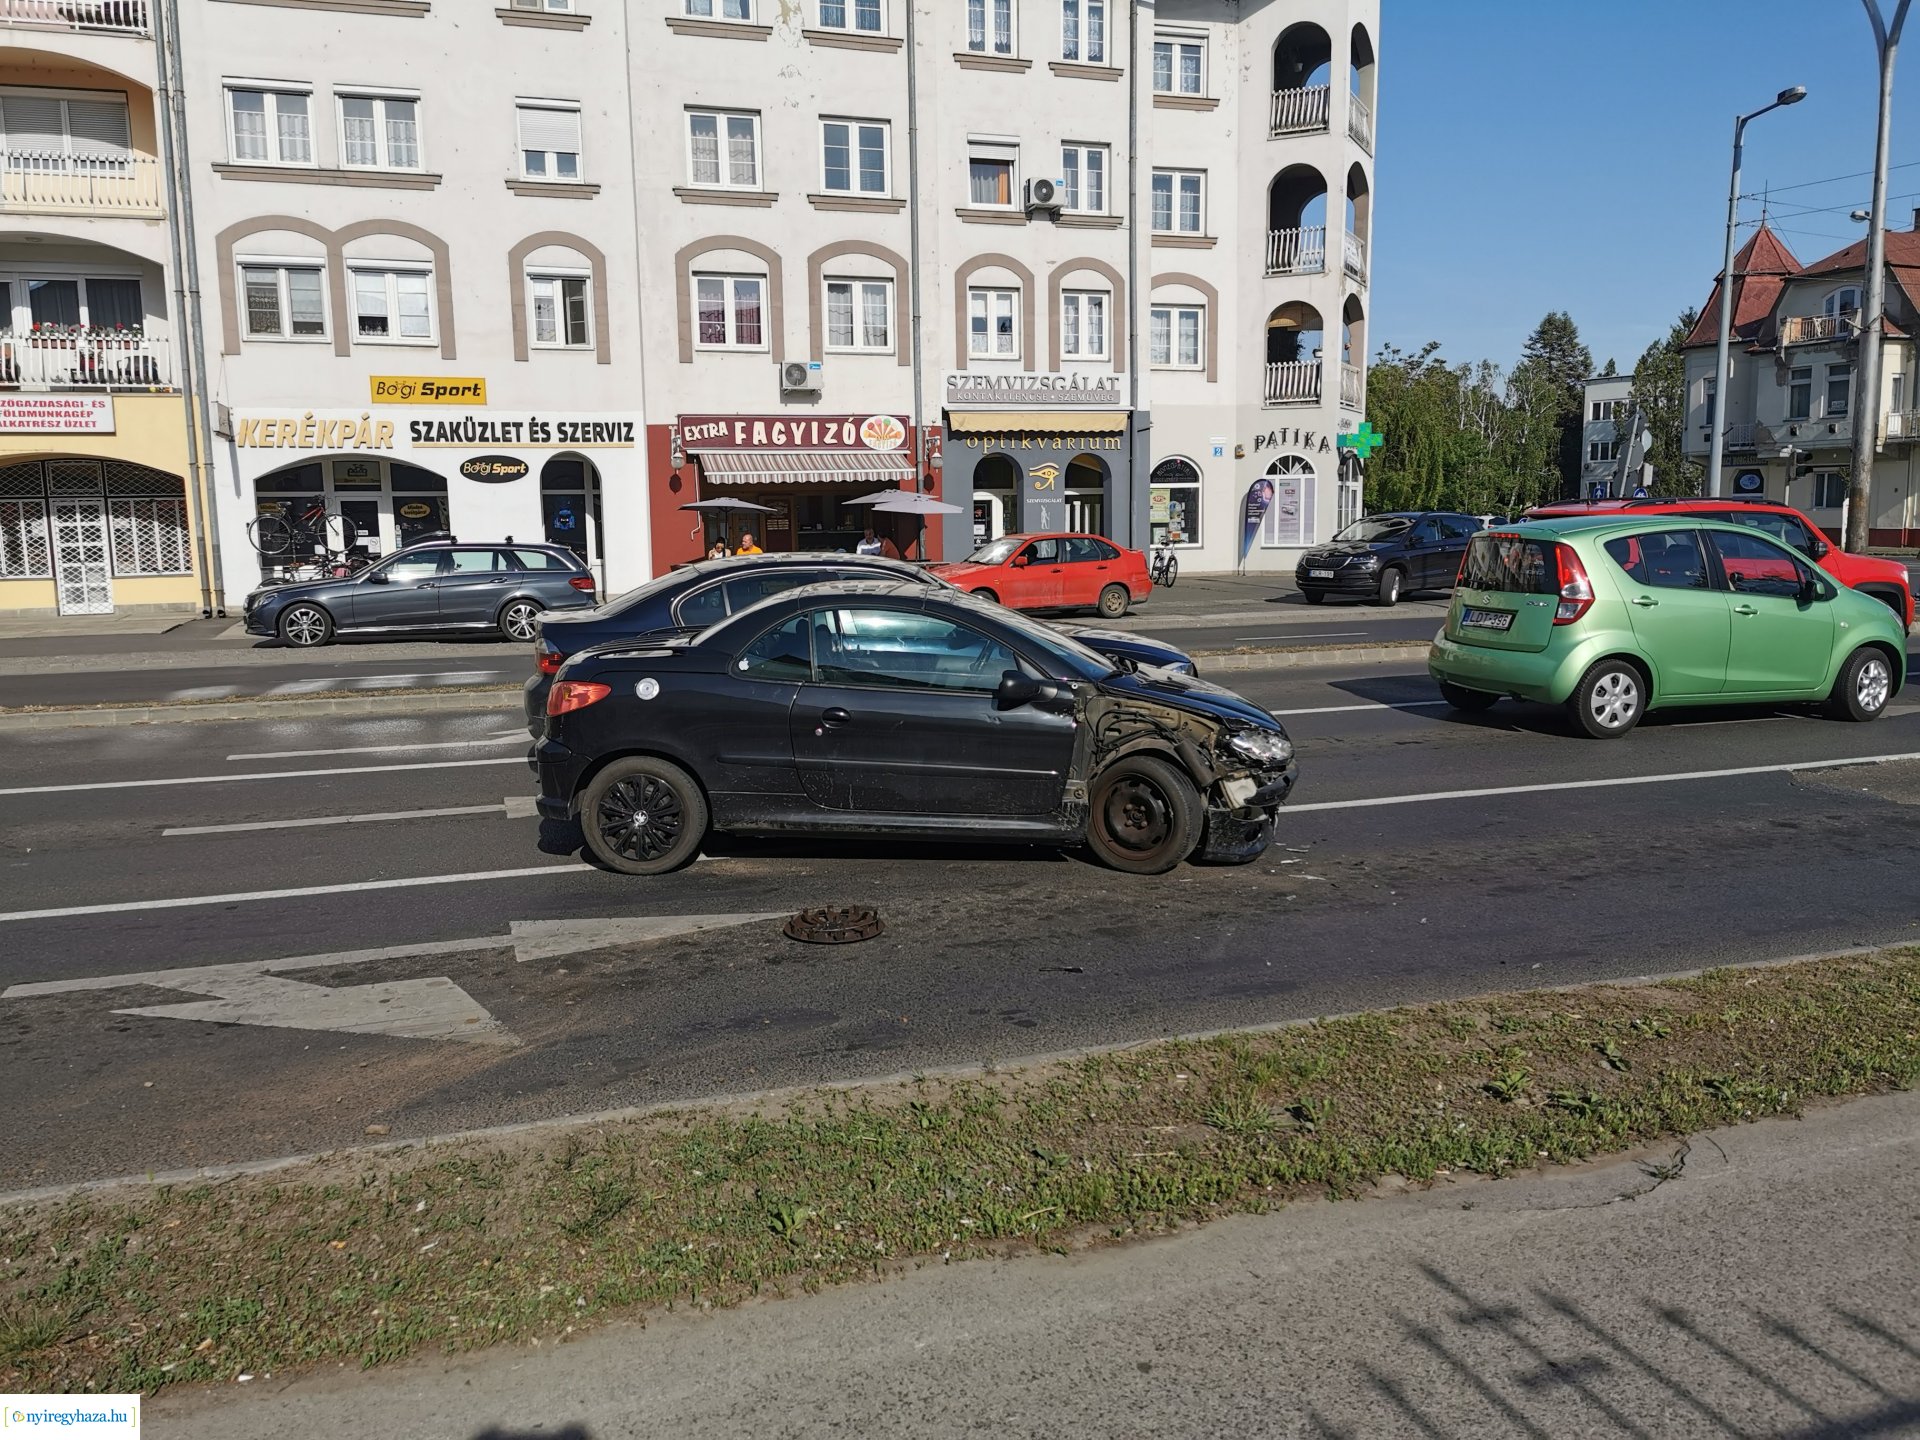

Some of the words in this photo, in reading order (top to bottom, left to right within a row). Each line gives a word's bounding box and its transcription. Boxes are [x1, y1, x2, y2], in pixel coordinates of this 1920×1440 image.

[946, 372, 1119, 391] SZEMVIZSGÁLAT
[420, 382, 481, 400] Sport
[1058, 392, 1114, 402] SZEMÜVEG
[91, 400, 106, 408] ÉS
[64, 419, 97, 428] ÜZLET
[237, 411, 394, 449] KERÉKPÁR
[410, 416, 523, 443] SZAKÜZLET
[529, 417, 550, 443] ÉS
[557, 422, 635, 443] SZERVIZ
[683, 421, 729, 442] EXTRA
[734, 417, 857, 446] FAGYIZÓ
[1254, 427, 1332, 454] PATIKA
[1215, 447, 1222, 457] 2
[492, 463, 526, 475] Sport
[1469, 611, 1510, 627] LDT-396
